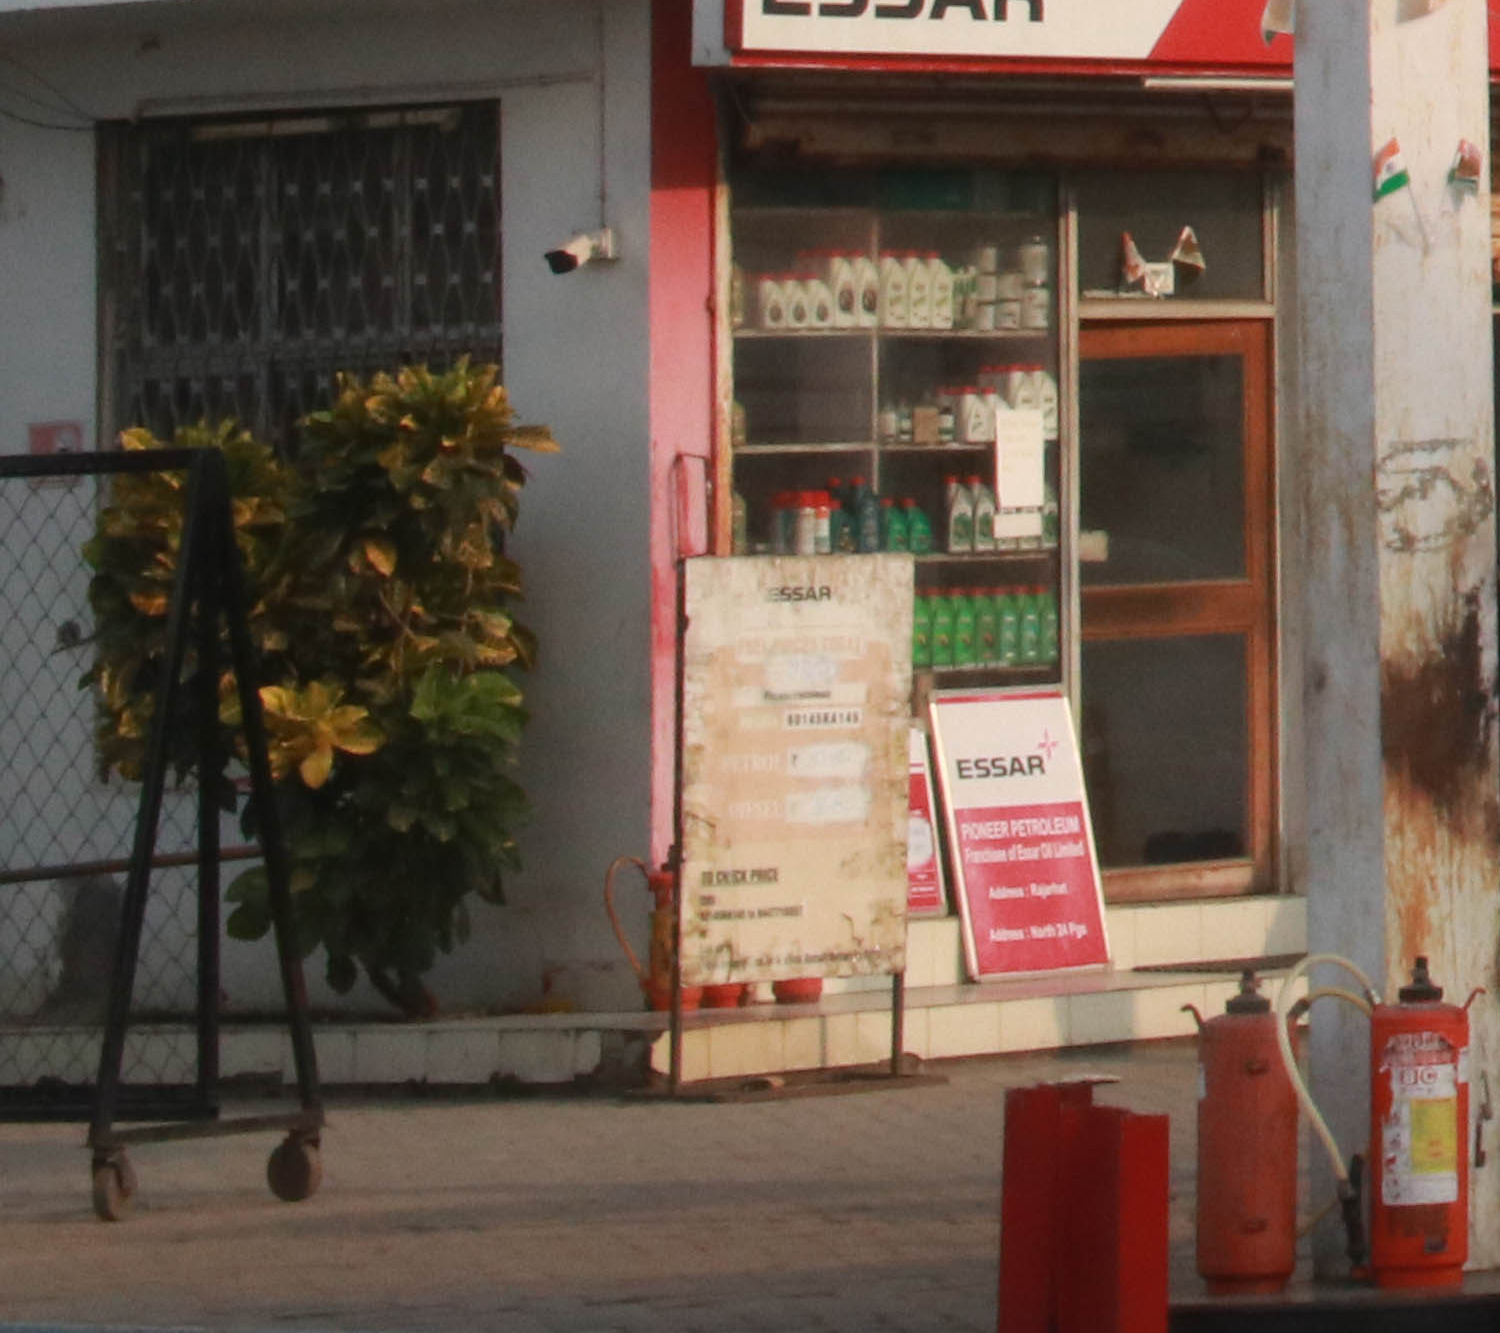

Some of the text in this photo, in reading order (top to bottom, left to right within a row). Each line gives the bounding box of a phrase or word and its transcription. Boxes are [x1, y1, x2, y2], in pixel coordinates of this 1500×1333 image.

[767, 586, 832, 602] ESSAR
[956, 754, 1046, 780] ESSAR
[961, 815, 1081, 840] PIONEER PETROLEUM
